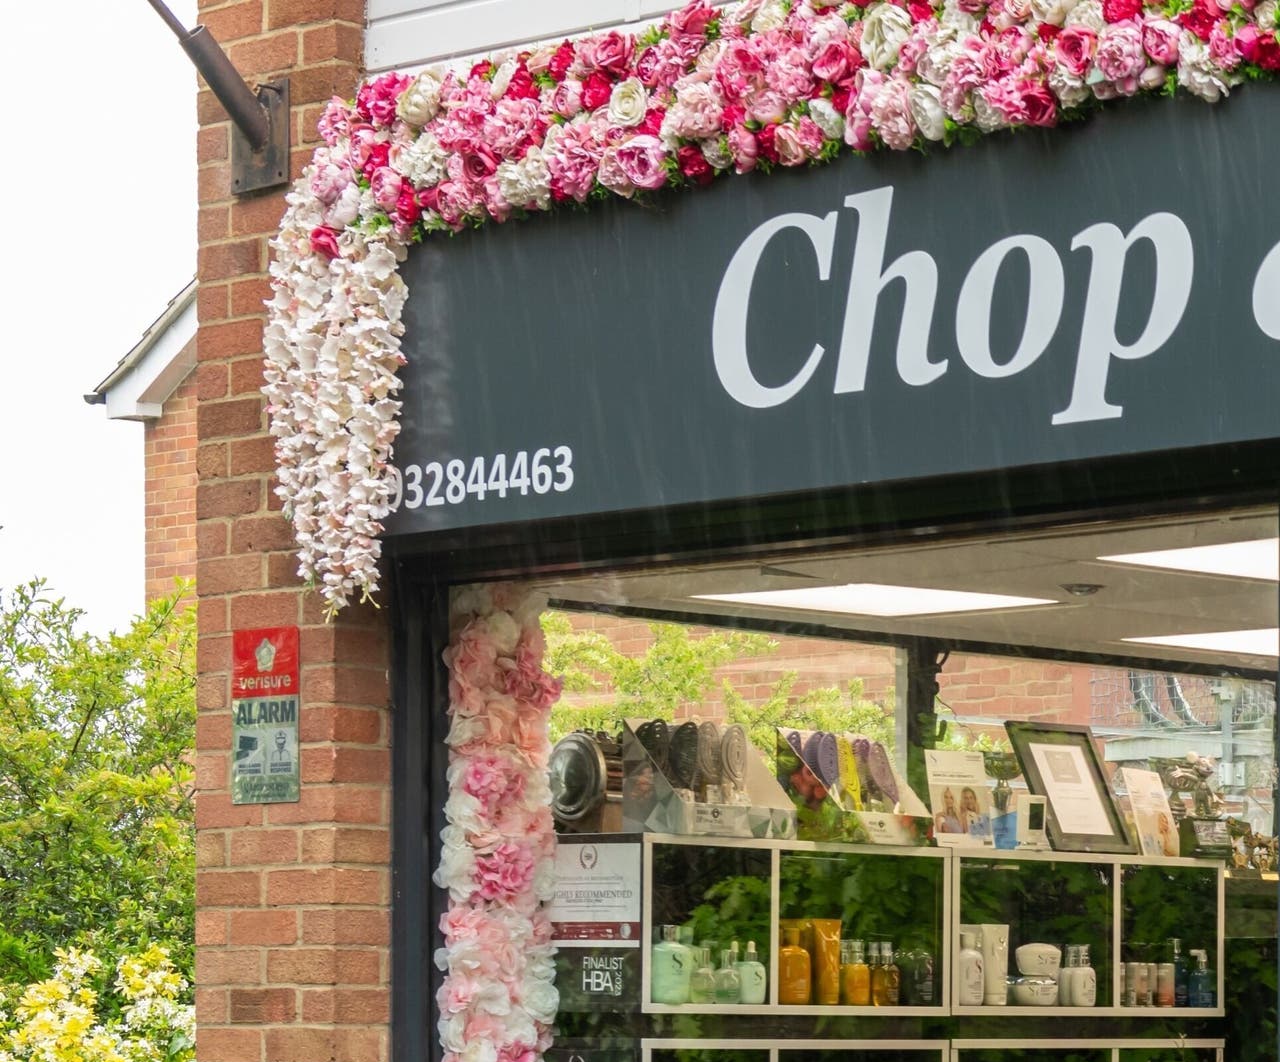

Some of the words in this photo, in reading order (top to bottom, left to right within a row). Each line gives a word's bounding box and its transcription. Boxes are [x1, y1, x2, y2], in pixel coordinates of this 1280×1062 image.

[711, 184, 1195, 426] Chop
[239, 674, 292, 690] verisure
[236, 700, 296, 726] ALARM
[583, 956, 625, 970] FINALIST
[582, 970, 614, 992] HBA
